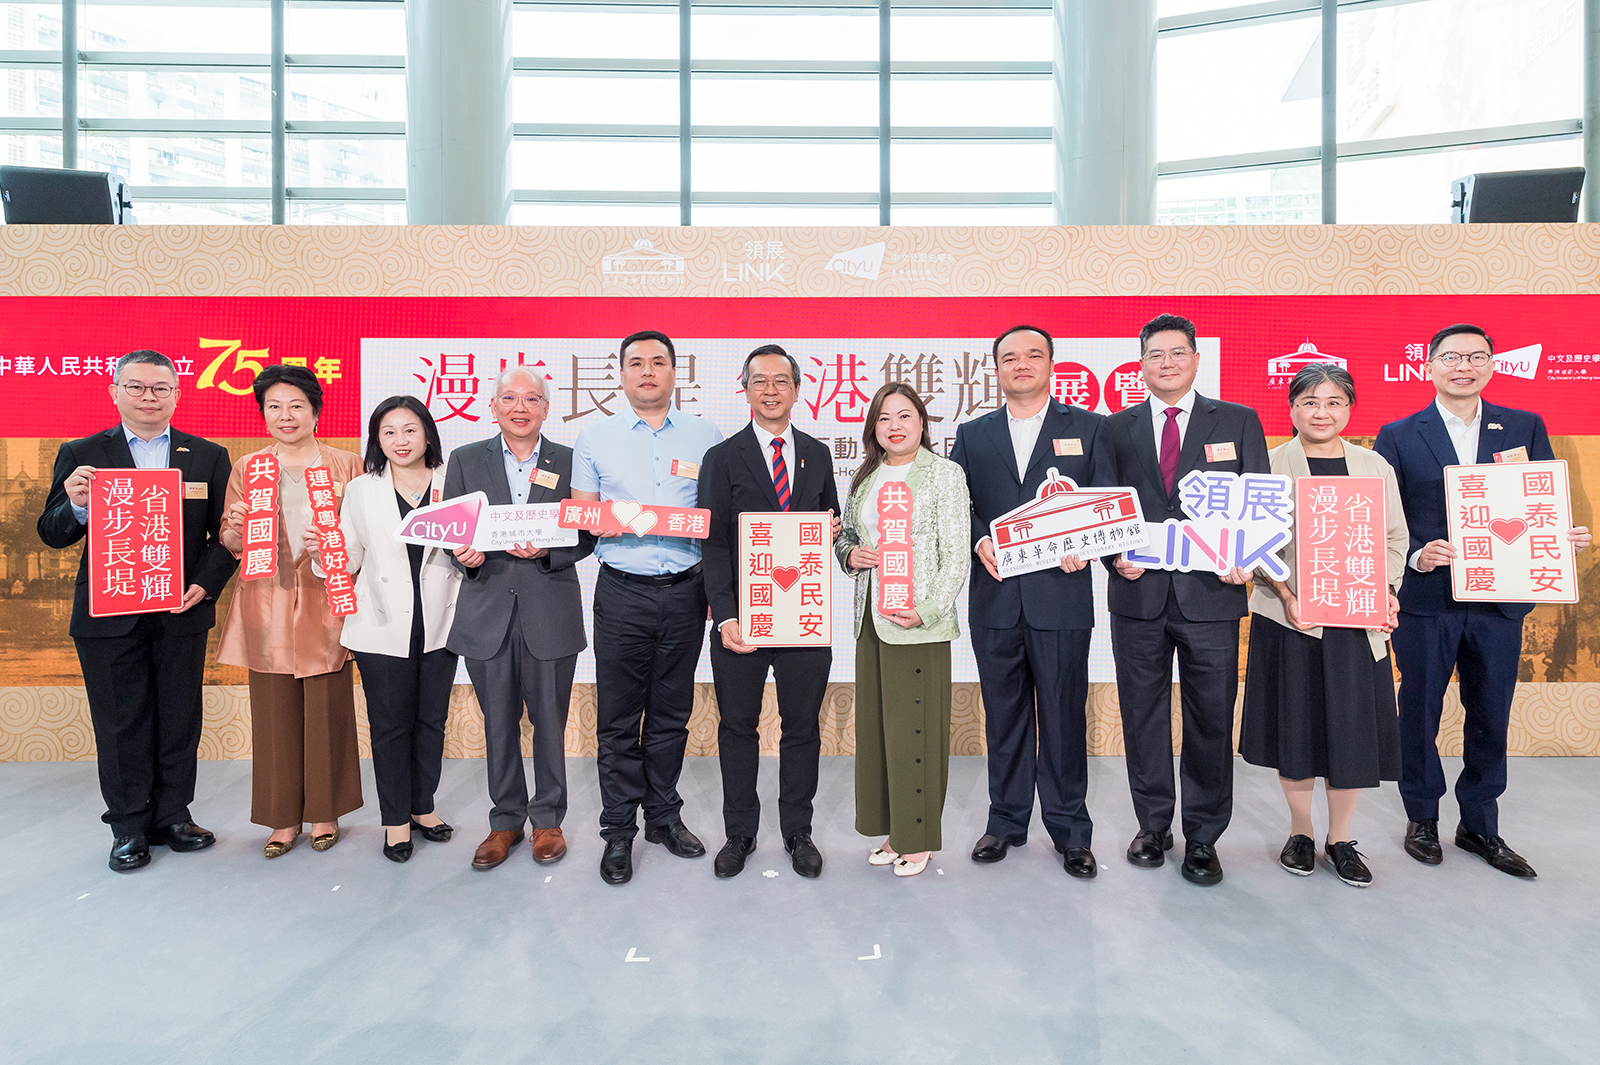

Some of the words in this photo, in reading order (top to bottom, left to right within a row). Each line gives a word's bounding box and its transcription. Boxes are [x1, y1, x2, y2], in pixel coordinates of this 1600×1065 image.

[723, 263, 785, 282] LINK
[744, 241, 785, 260] 領展
[831, 258, 873, 276] CityU
[196, 337, 269, 396] 75
[281, 356, 342, 384] 年
[1384, 363, 1432, 382] LIN
[1404, 344, 1430, 362] 領
[245, 457, 275, 576] 共賀國慶
[490, 508, 560, 522] 中文及歷史學
[563, 505, 601, 526] 廣州
[668, 513, 705, 533] 香港
[1184, 475, 1288, 523] 領展
[102, 478, 136, 598] 漫步長堤
[139, 485, 173, 604] 省港雙輝
[410, 521, 467, 542] CityU
[491, 528, 543, 538] 香港城市大學
[882, 486, 909, 610] 共賀國慶
[1002, 523, 1140, 567] 廣東革命歷史博物館
[1003, 562, 1033, 573] GUANGDONG
[1036, 557, 1057, 566] MUSEUM
[1118, 538, 1144, 548] HISTORY
[1127, 524, 1285, 576] LINK
[1308, 485, 1341, 607] 漫步長堤
[1343, 493, 1378, 618] 省港雙輝
[1458, 473, 1496, 592] 喜迎國慶
[1522, 471, 1562, 593] 國泰民安
[749, 522, 773, 638] 喜迎國慶
[799, 522, 823, 637] 國泰民安
